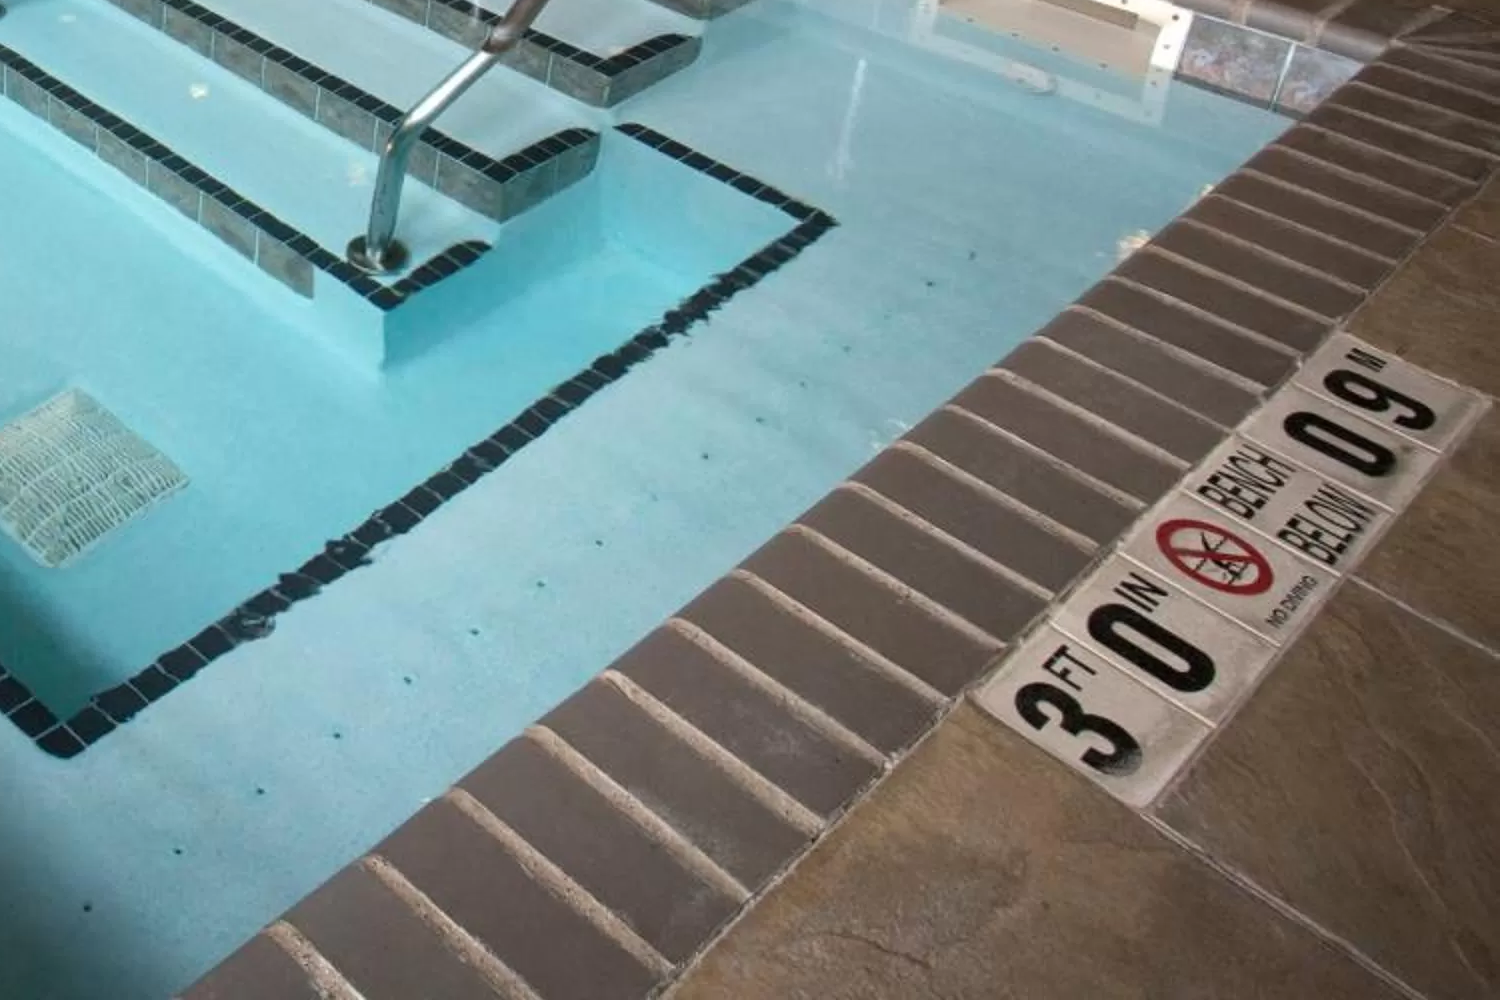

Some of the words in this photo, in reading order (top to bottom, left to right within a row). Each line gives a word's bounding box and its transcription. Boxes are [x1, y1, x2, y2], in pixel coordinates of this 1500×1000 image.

[1196, 443, 1296, 521] BENCH
[1276, 483, 1380, 566] BELOW
[1265, 603, 1287, 630] NO
[1282, 574, 1319, 615] DIVING
